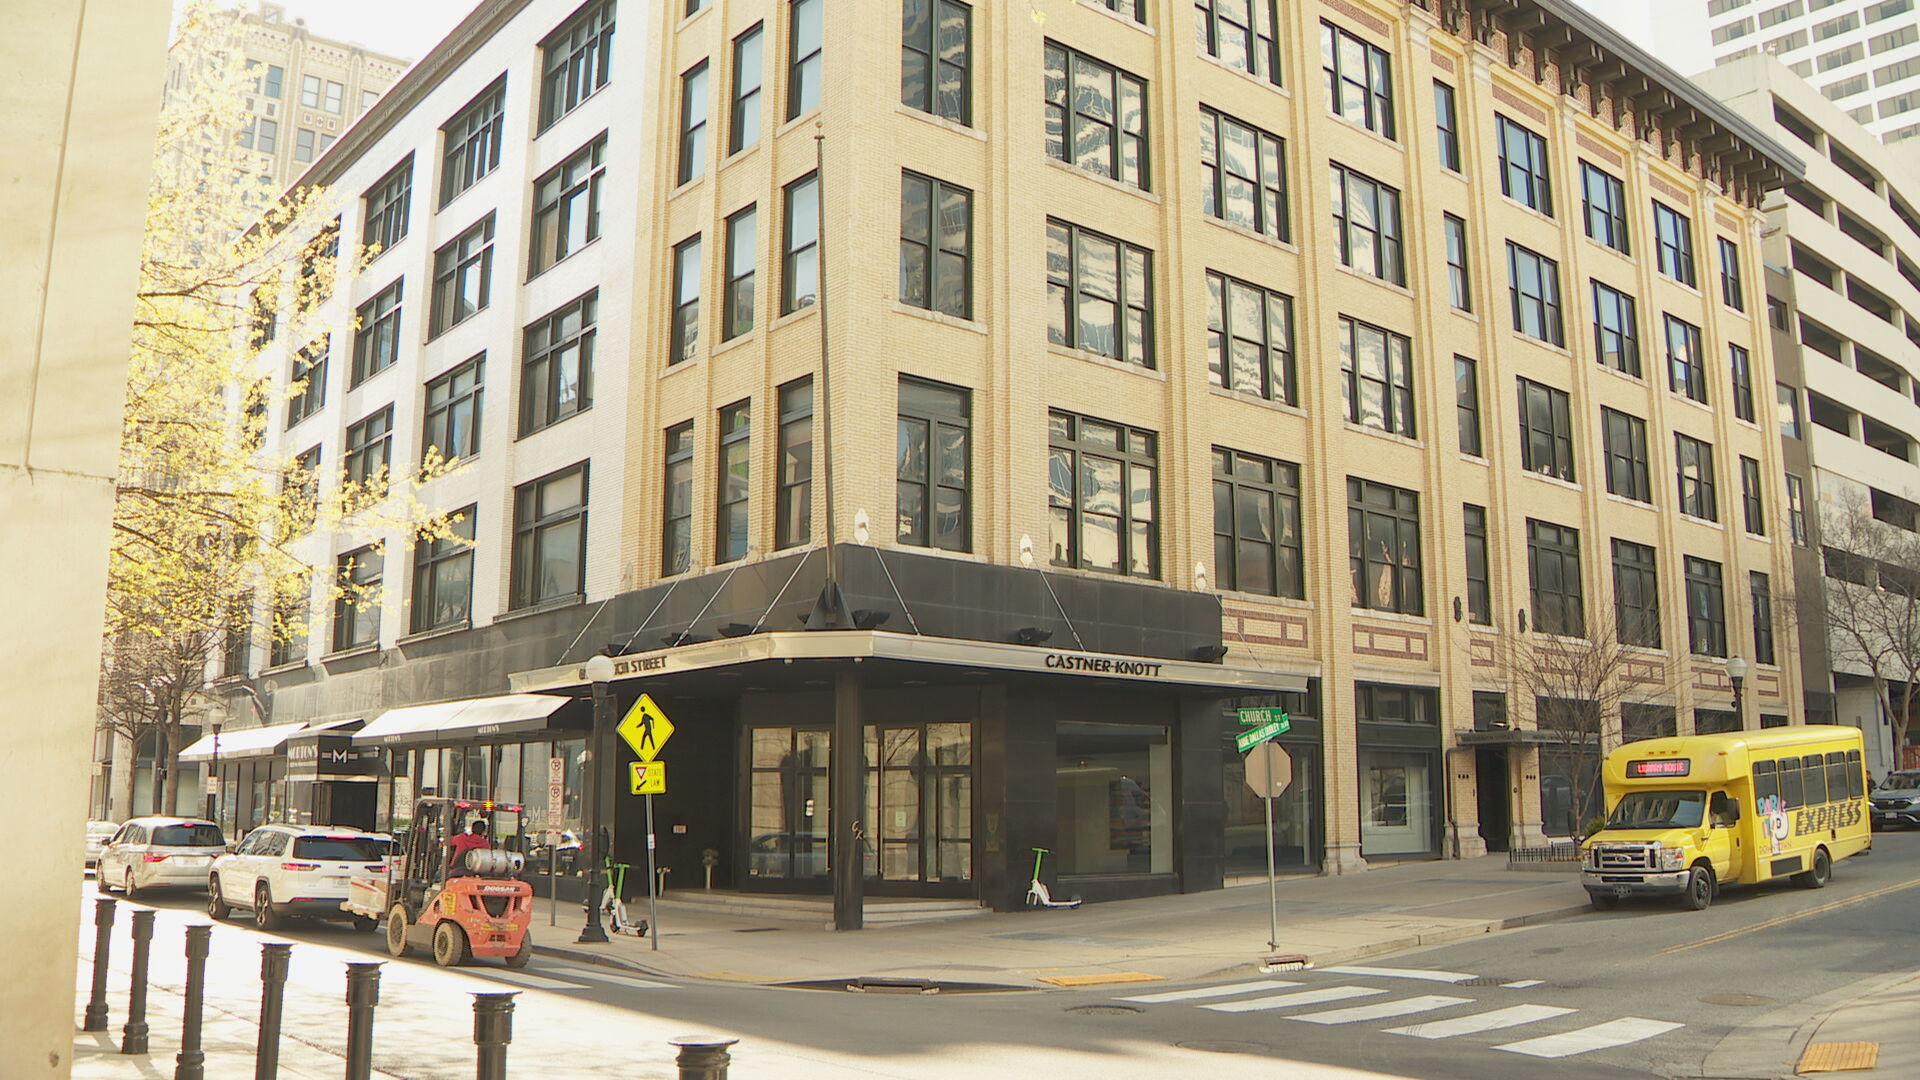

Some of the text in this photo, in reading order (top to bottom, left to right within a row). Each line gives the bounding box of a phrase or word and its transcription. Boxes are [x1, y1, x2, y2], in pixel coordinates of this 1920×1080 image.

[630, 655, 667, 673] STREET
[1046, 655, 1161, 676] CASTNER-KNOTT
[1240, 710, 1271, 723] CHURCH
[1795, 801, 1861, 837] EXPRESS
